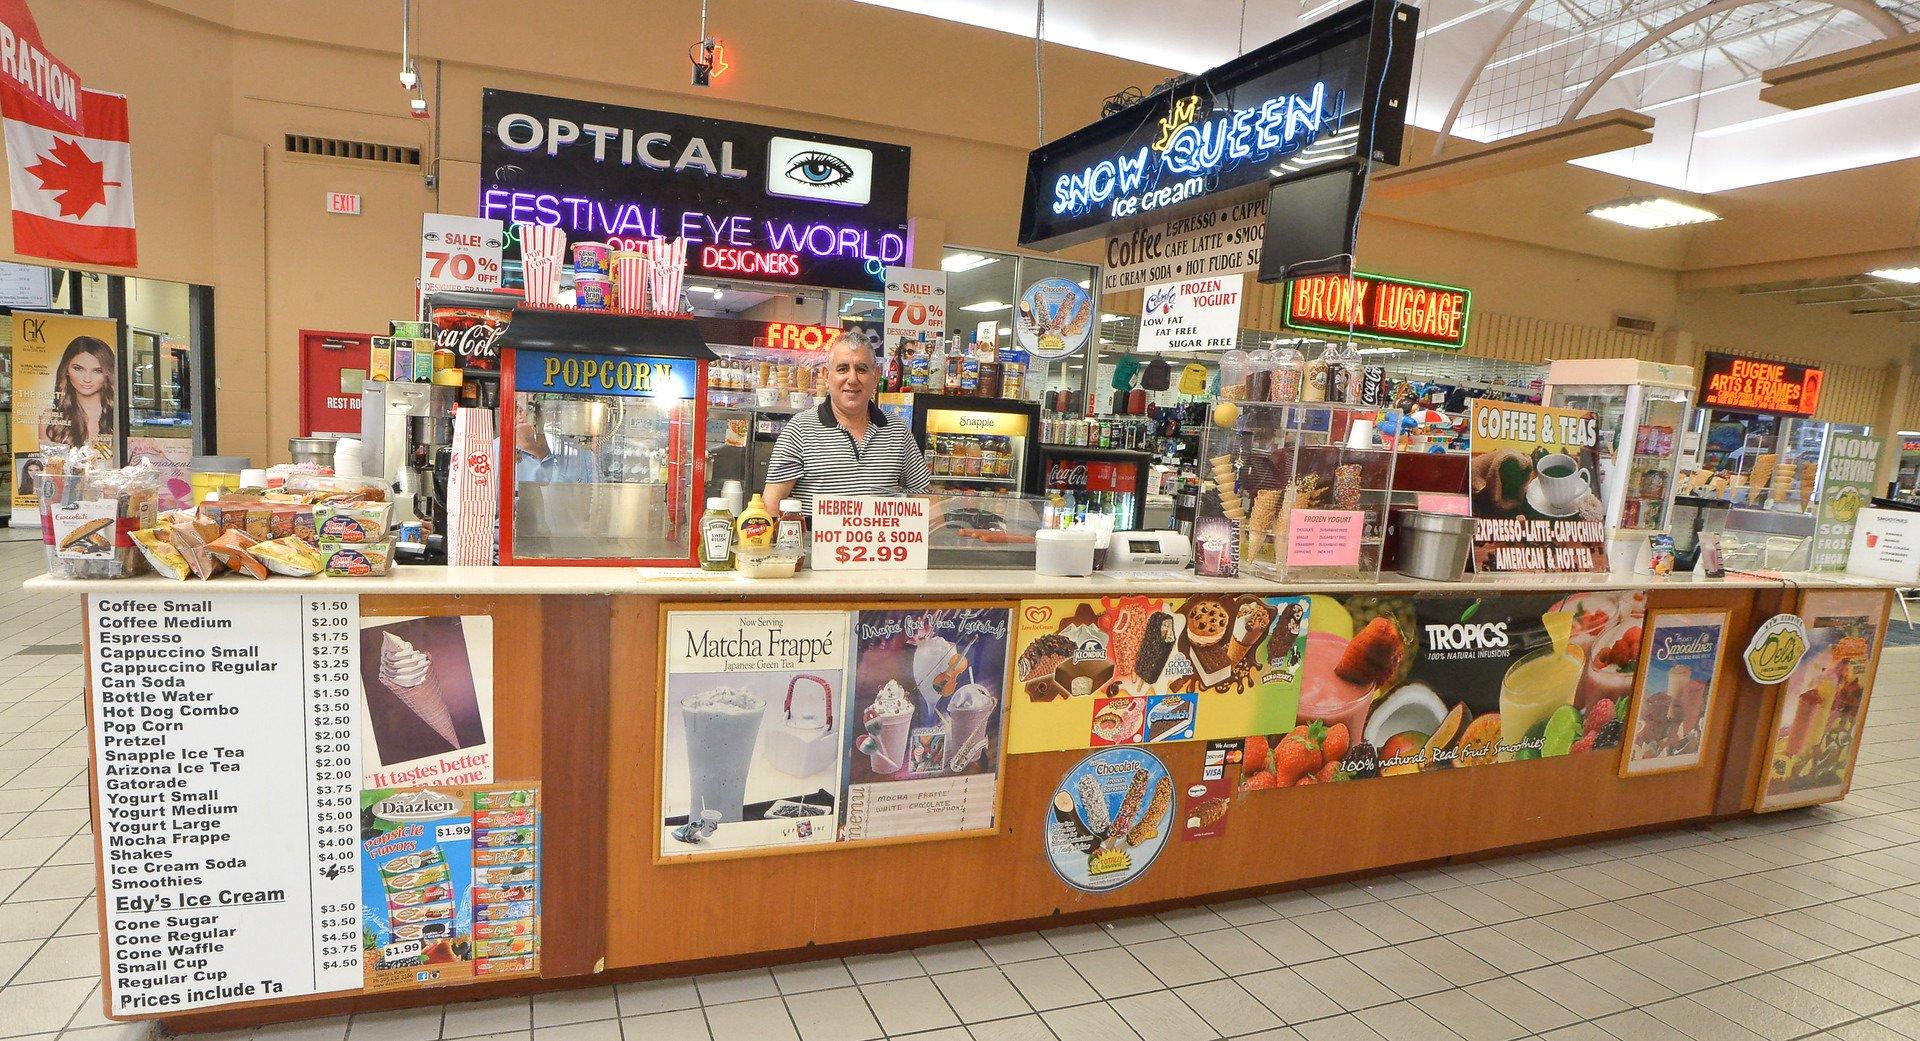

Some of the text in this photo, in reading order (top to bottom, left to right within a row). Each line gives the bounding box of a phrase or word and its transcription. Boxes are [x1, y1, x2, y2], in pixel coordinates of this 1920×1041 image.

[498, 113, 748, 179] OPTICAL
[1052, 81, 1324, 214] SNOW QUEEN
[333, 194, 356, 213] EXIT
[1112, 176, 1203, 218] Ice cream
[484, 189, 904, 263] FESTIVAL EYE WORLD
[1166, 212, 1217, 238] ESPRESSO
[445, 232, 481, 248] SALE!
[1107, 224, 1162, 270] Coffee
[1165, 236, 1188, 258] CAFE
[1191, 232, 1223, 253] LATTE
[703, 246, 799, 277] DESIGNERS
[1105, 275, 1117, 289] ICE
[1120, 270, 1146, 288] CREAM
[1149, 265, 1172, 281] SODA
[1186, 258, 1204, 276] HOT
[1208, 251, 1243, 272] FUDGE
[478, 274, 498, 283] OFF!
[903, 283, 931, 295] SALE!
[1180, 279, 1222, 296] FROZEN
[1193, 292, 1238, 308] YOGURT
[1298, 275, 1463, 338] BRONX LUGGAGE
[928, 318, 943, 327] OFF!
[1143, 316, 1184, 326] LOW FAT
[23, 318, 46, 343] GK
[887, 327, 917, 338] DESIGNER
[1155, 327, 1198, 336] FAT FREE
[1168, 338, 1232, 348] SUGAR FREE
[544, 358, 672, 392] POPCORN
[1731, 360, 1785, 382] EUGENE
[1709, 374, 1801, 399] ARTS & FRAMES
[327, 398, 347, 409] REST
[959, 415, 995, 429] Snapple
[1477, 407, 1597, 447] COFFEE & TEAS
[1833, 438, 1880, 459] NOW
[1829, 458, 1876, 482] SERVING
[818, 500, 923, 517] HEBREW NATIONAL
[843, 517, 900, 527] KOSHER
[814, 531, 842, 543] HOT
[846, 531, 874, 543] DOG
[877, 531, 886, 543] &
[890, 531, 923, 543] SODA
[835, 545, 908, 563] $2.99
[1230, 519, 1241, 576] FRAPPES
[1497, 547, 1593, 570] AMERICAN & HOT TEA
[99, 600, 211, 612] Coffee Small
[312, 602, 347, 611] $1.50
[740, 617, 784, 627] Now Serving
[862, 620, 902, 639] Music
[904, 615, 925, 638] for
[927, 609, 956, 641] Your
[100, 632, 181, 645] Espresso
[1425, 623, 1509, 650] TROPICS
[686, 628, 833, 664] Matcha Frappé
[1073, 650, 1106, 664] KLONDIKE
[1427, 650, 1510, 661] 100% NATURAL INFUSIONS
[724, 660, 795, 671] Japanese Green Tea
[1168, 660, 1191, 669] GOOD
[104, 705, 239, 719] Hot Dog Combo
[314, 703, 349, 713] $3.50
[104, 721, 183, 734] Pop Corn
[105, 735, 165, 746] Pretzel
[106, 747, 244, 763] Snapple Ice Tea
[1340, 760, 1375, 773] 100%
[1433, 746, 1456, 761] Real
[1461, 743, 1491, 764] fruit
[1494, 736, 1546, 756] Smoothies
[390, 765, 438, 784] tastes
[440, 753, 489, 773] better
[1096, 760, 1141, 775] Chocolate
[107, 778, 186, 789] Gatorade
[382, 799, 454, 815] Däazken
[876, 801, 950, 813] WHITE CHOCOLATE
[110, 833, 230, 846] Mocha Frappe
[437, 826, 471, 837] $1.99
[111, 849, 172, 860] Shakes
[112, 876, 202, 889] Smoothies
[117, 890, 285, 913] Edy's Ice Cream
[321, 903, 355, 914] $3.50
[115, 916, 218, 930] Cone Sugar
[386, 943, 419, 957] $1.99
[121, 980, 282, 1009] Prices include Ta
